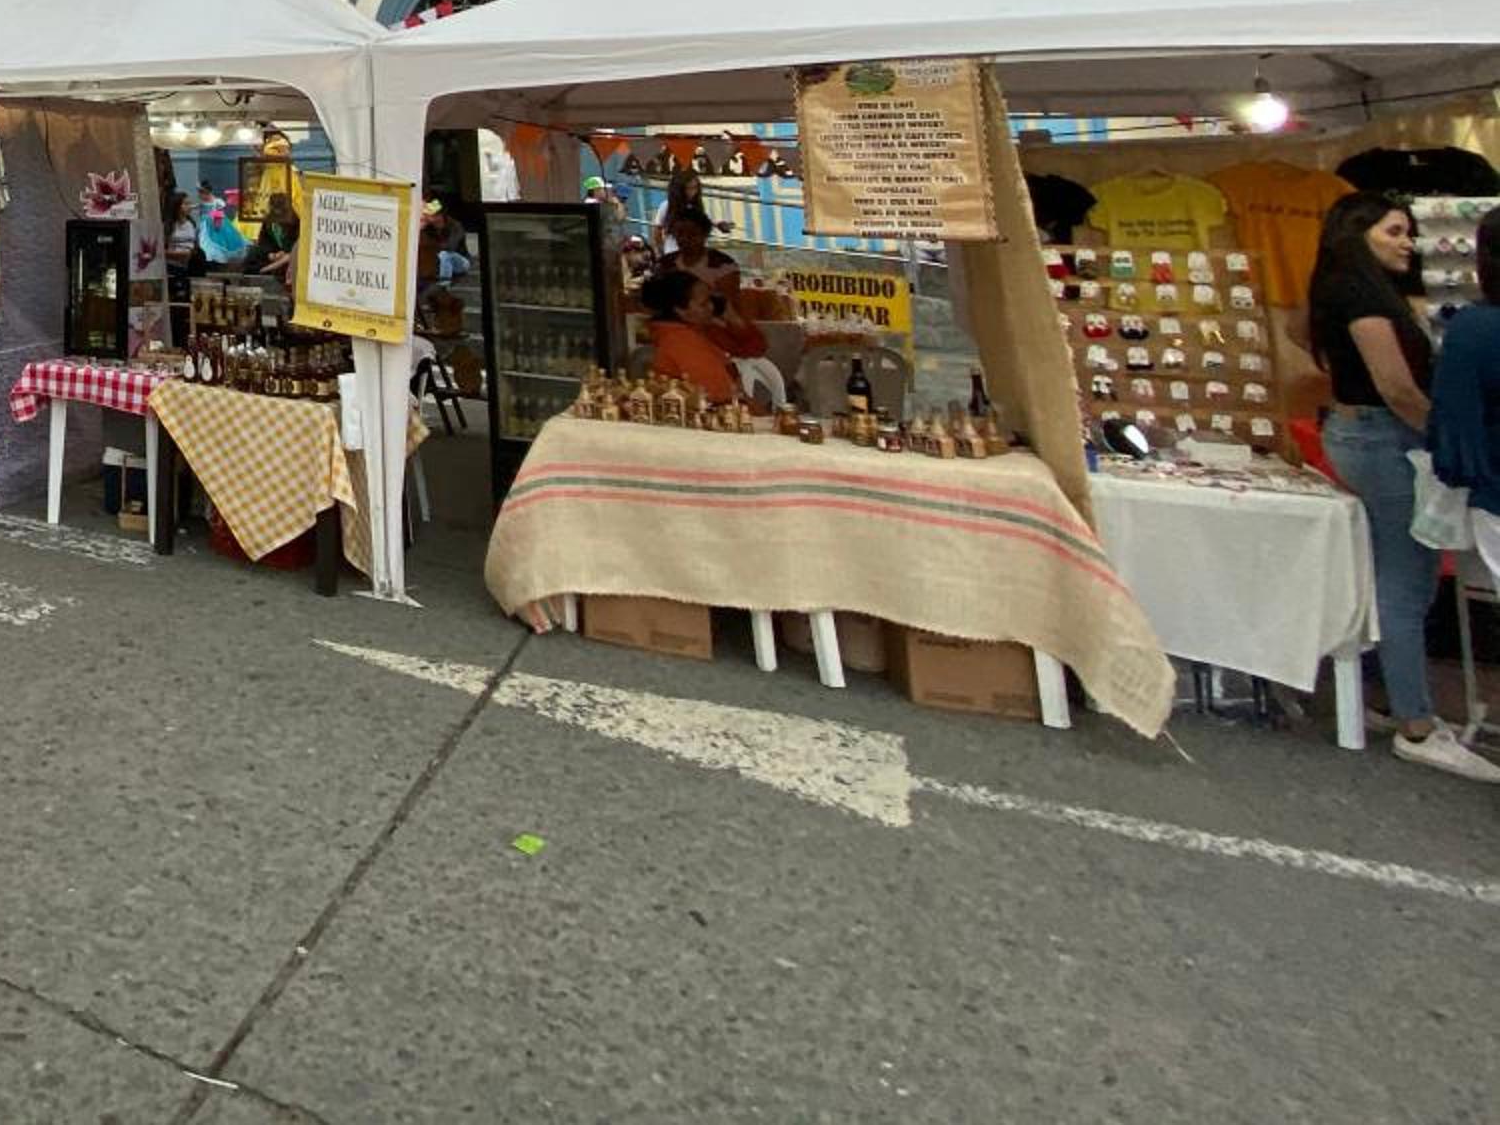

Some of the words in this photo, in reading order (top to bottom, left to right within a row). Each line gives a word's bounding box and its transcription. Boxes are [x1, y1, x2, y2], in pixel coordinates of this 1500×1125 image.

[317, 194, 348, 212] MIEL
[316, 216, 392, 241] PROPOLEOS
[315, 240, 357, 260] POLEN
[314, 263, 352, 285] JALEA
[355, 270, 389, 290] REAL
[798, 300, 891, 327] ARQUEAR
